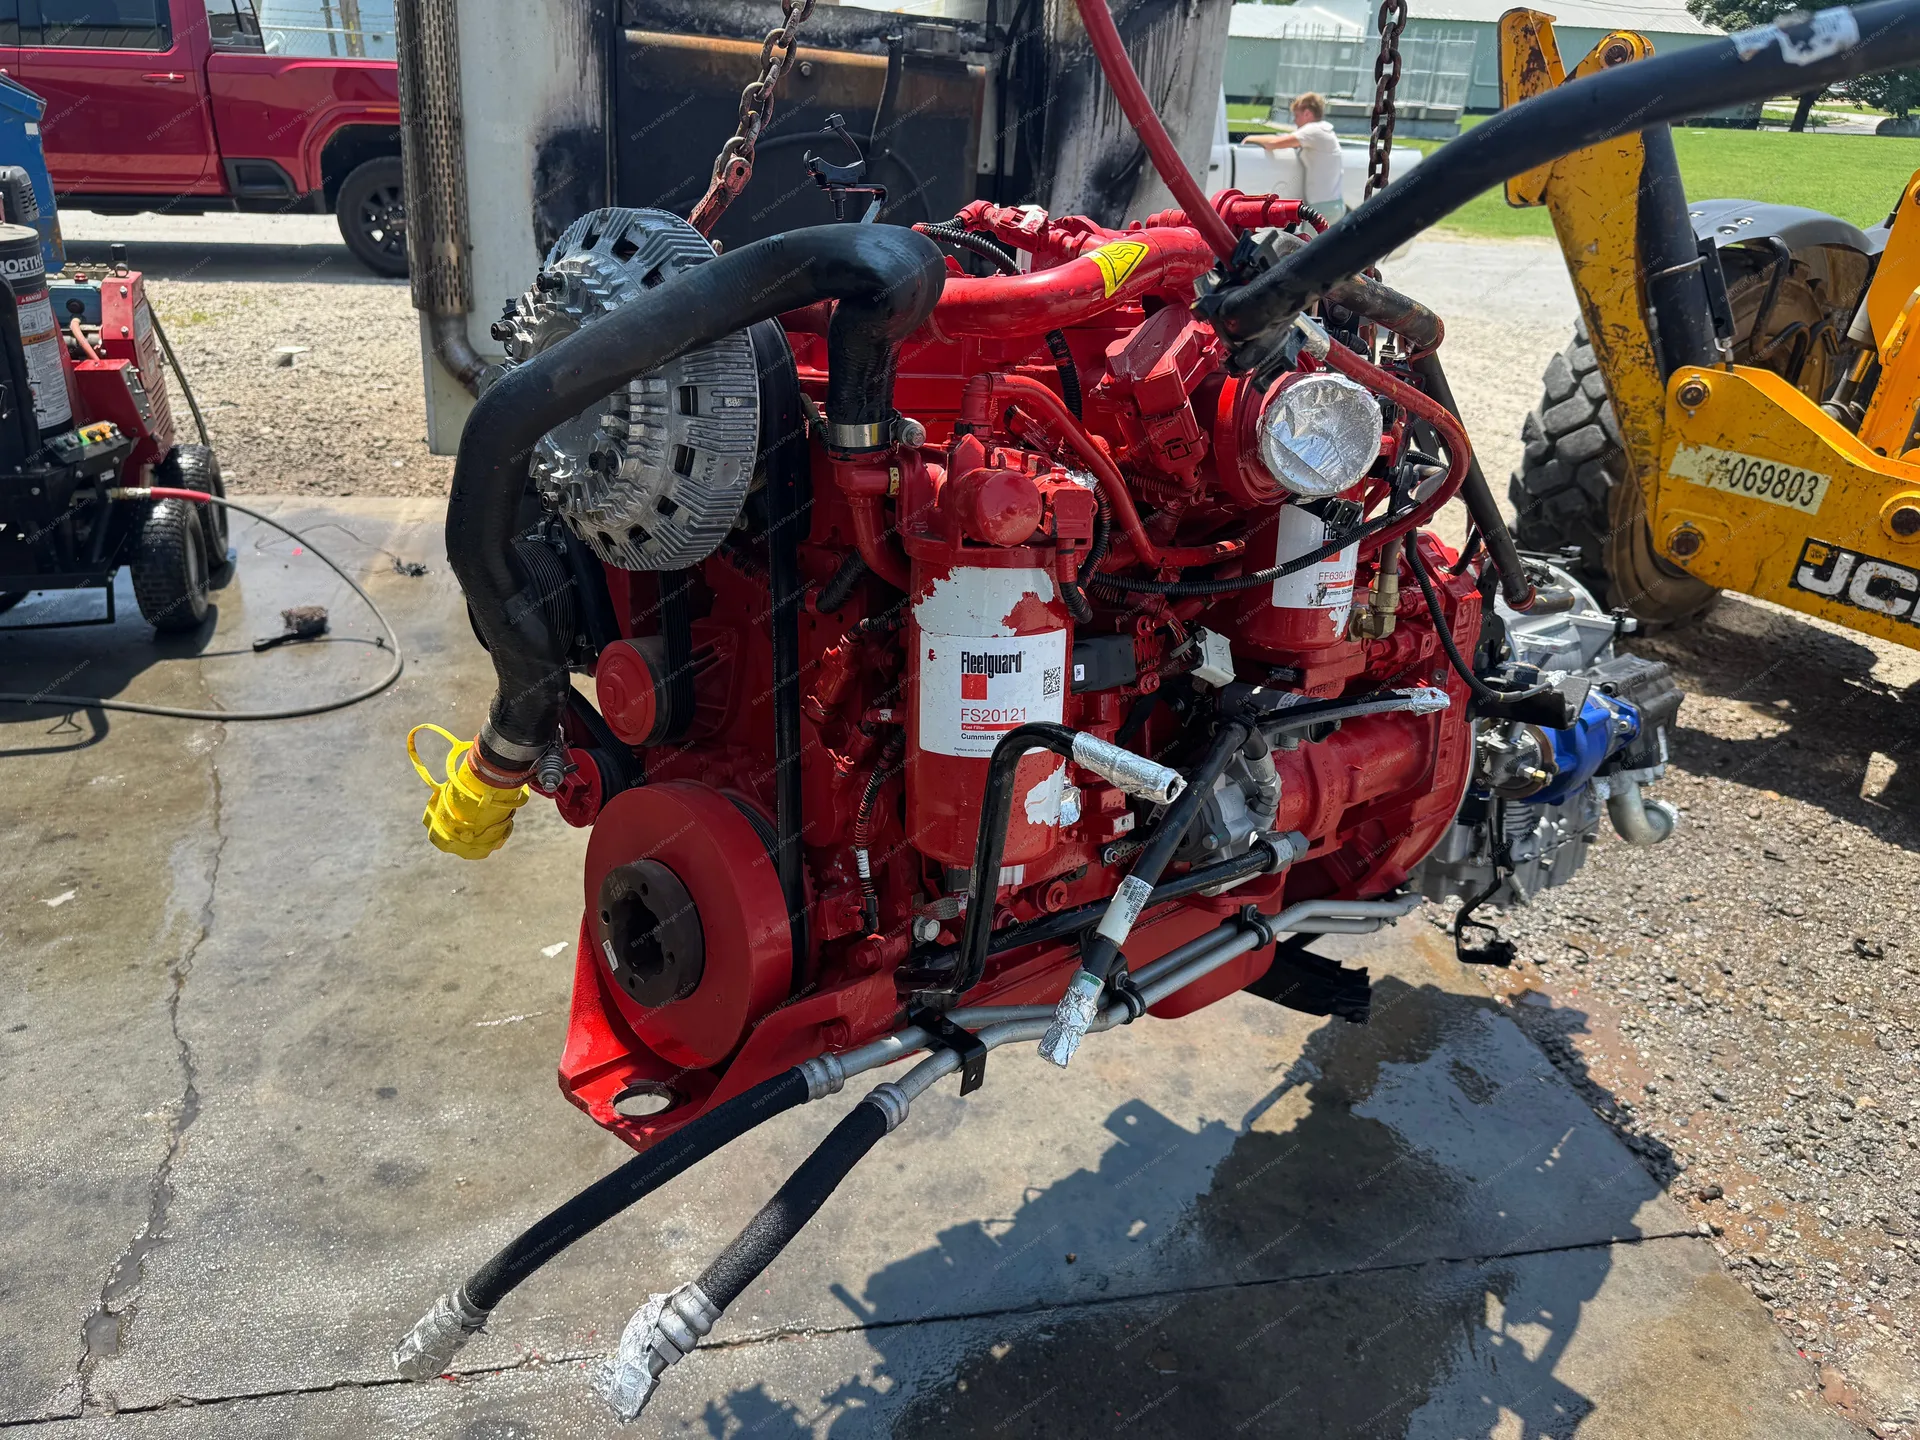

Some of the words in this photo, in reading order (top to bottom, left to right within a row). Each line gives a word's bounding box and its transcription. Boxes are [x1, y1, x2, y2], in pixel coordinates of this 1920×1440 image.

[1729, 457, 1819, 507] 069803
[961, 650, 1022, 679] Fleetguard
[961, 707, 1026, 722] FS20121
[961, 733, 995, 741] Cummins
